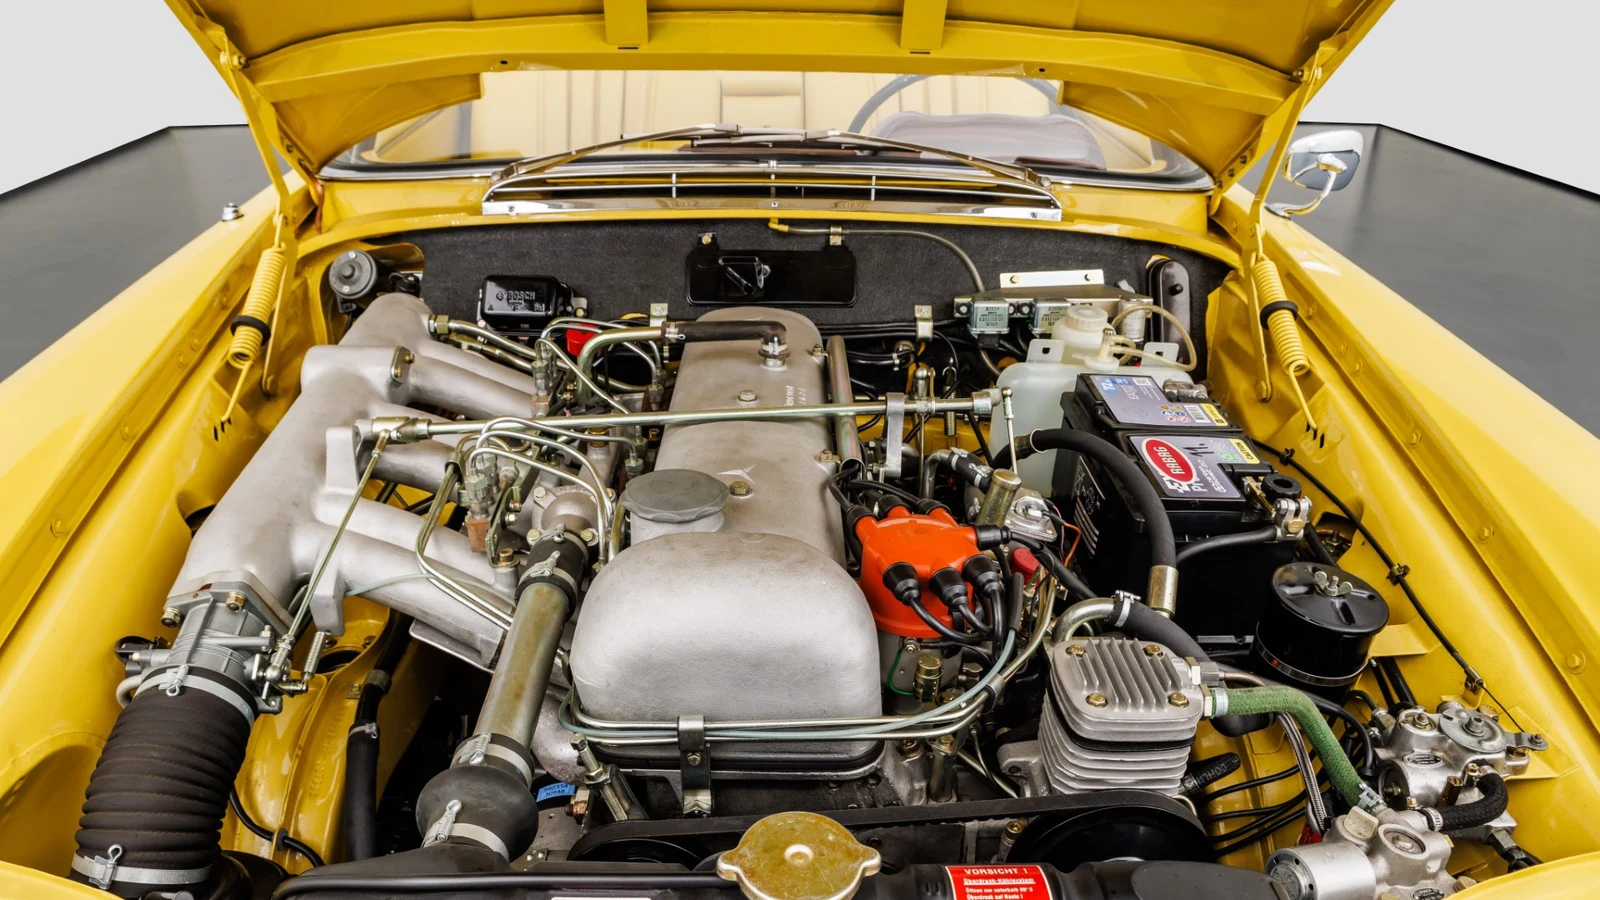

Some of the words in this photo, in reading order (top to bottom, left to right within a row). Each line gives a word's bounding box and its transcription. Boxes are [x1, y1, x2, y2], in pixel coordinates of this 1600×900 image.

[507, 290, 535, 300] BOSCH
[1153, 446, 1185, 475] RABAG
[963, 867, 1018, 875] VORSICHT
